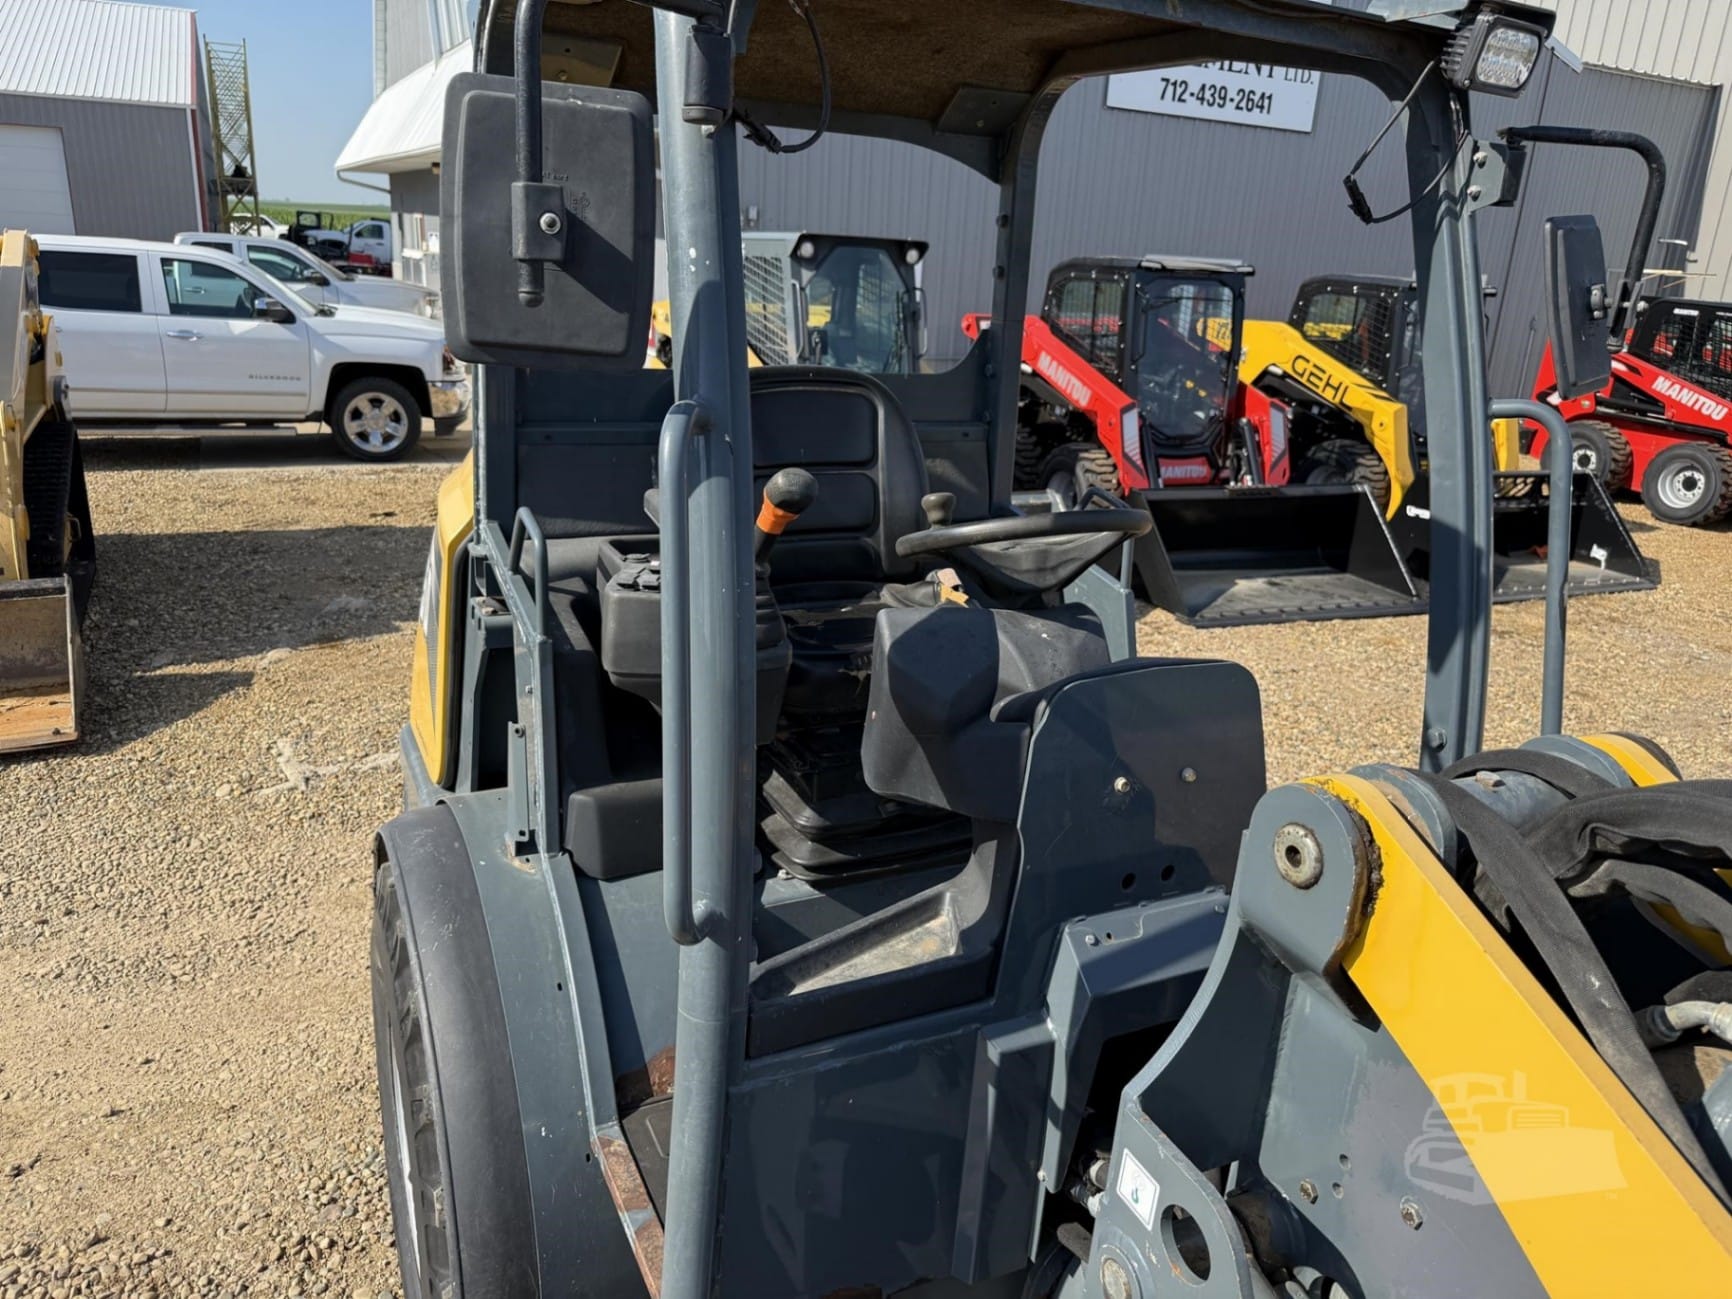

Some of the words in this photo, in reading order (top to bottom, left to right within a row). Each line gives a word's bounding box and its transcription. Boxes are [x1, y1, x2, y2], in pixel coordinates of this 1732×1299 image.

[1160, 77, 1273, 115] 712-439-2641
[1037, 350, 1093, 407] MANITOU
[1291, 354, 1353, 411] GEHL
[1651, 375, 1729, 421] MANITOU
